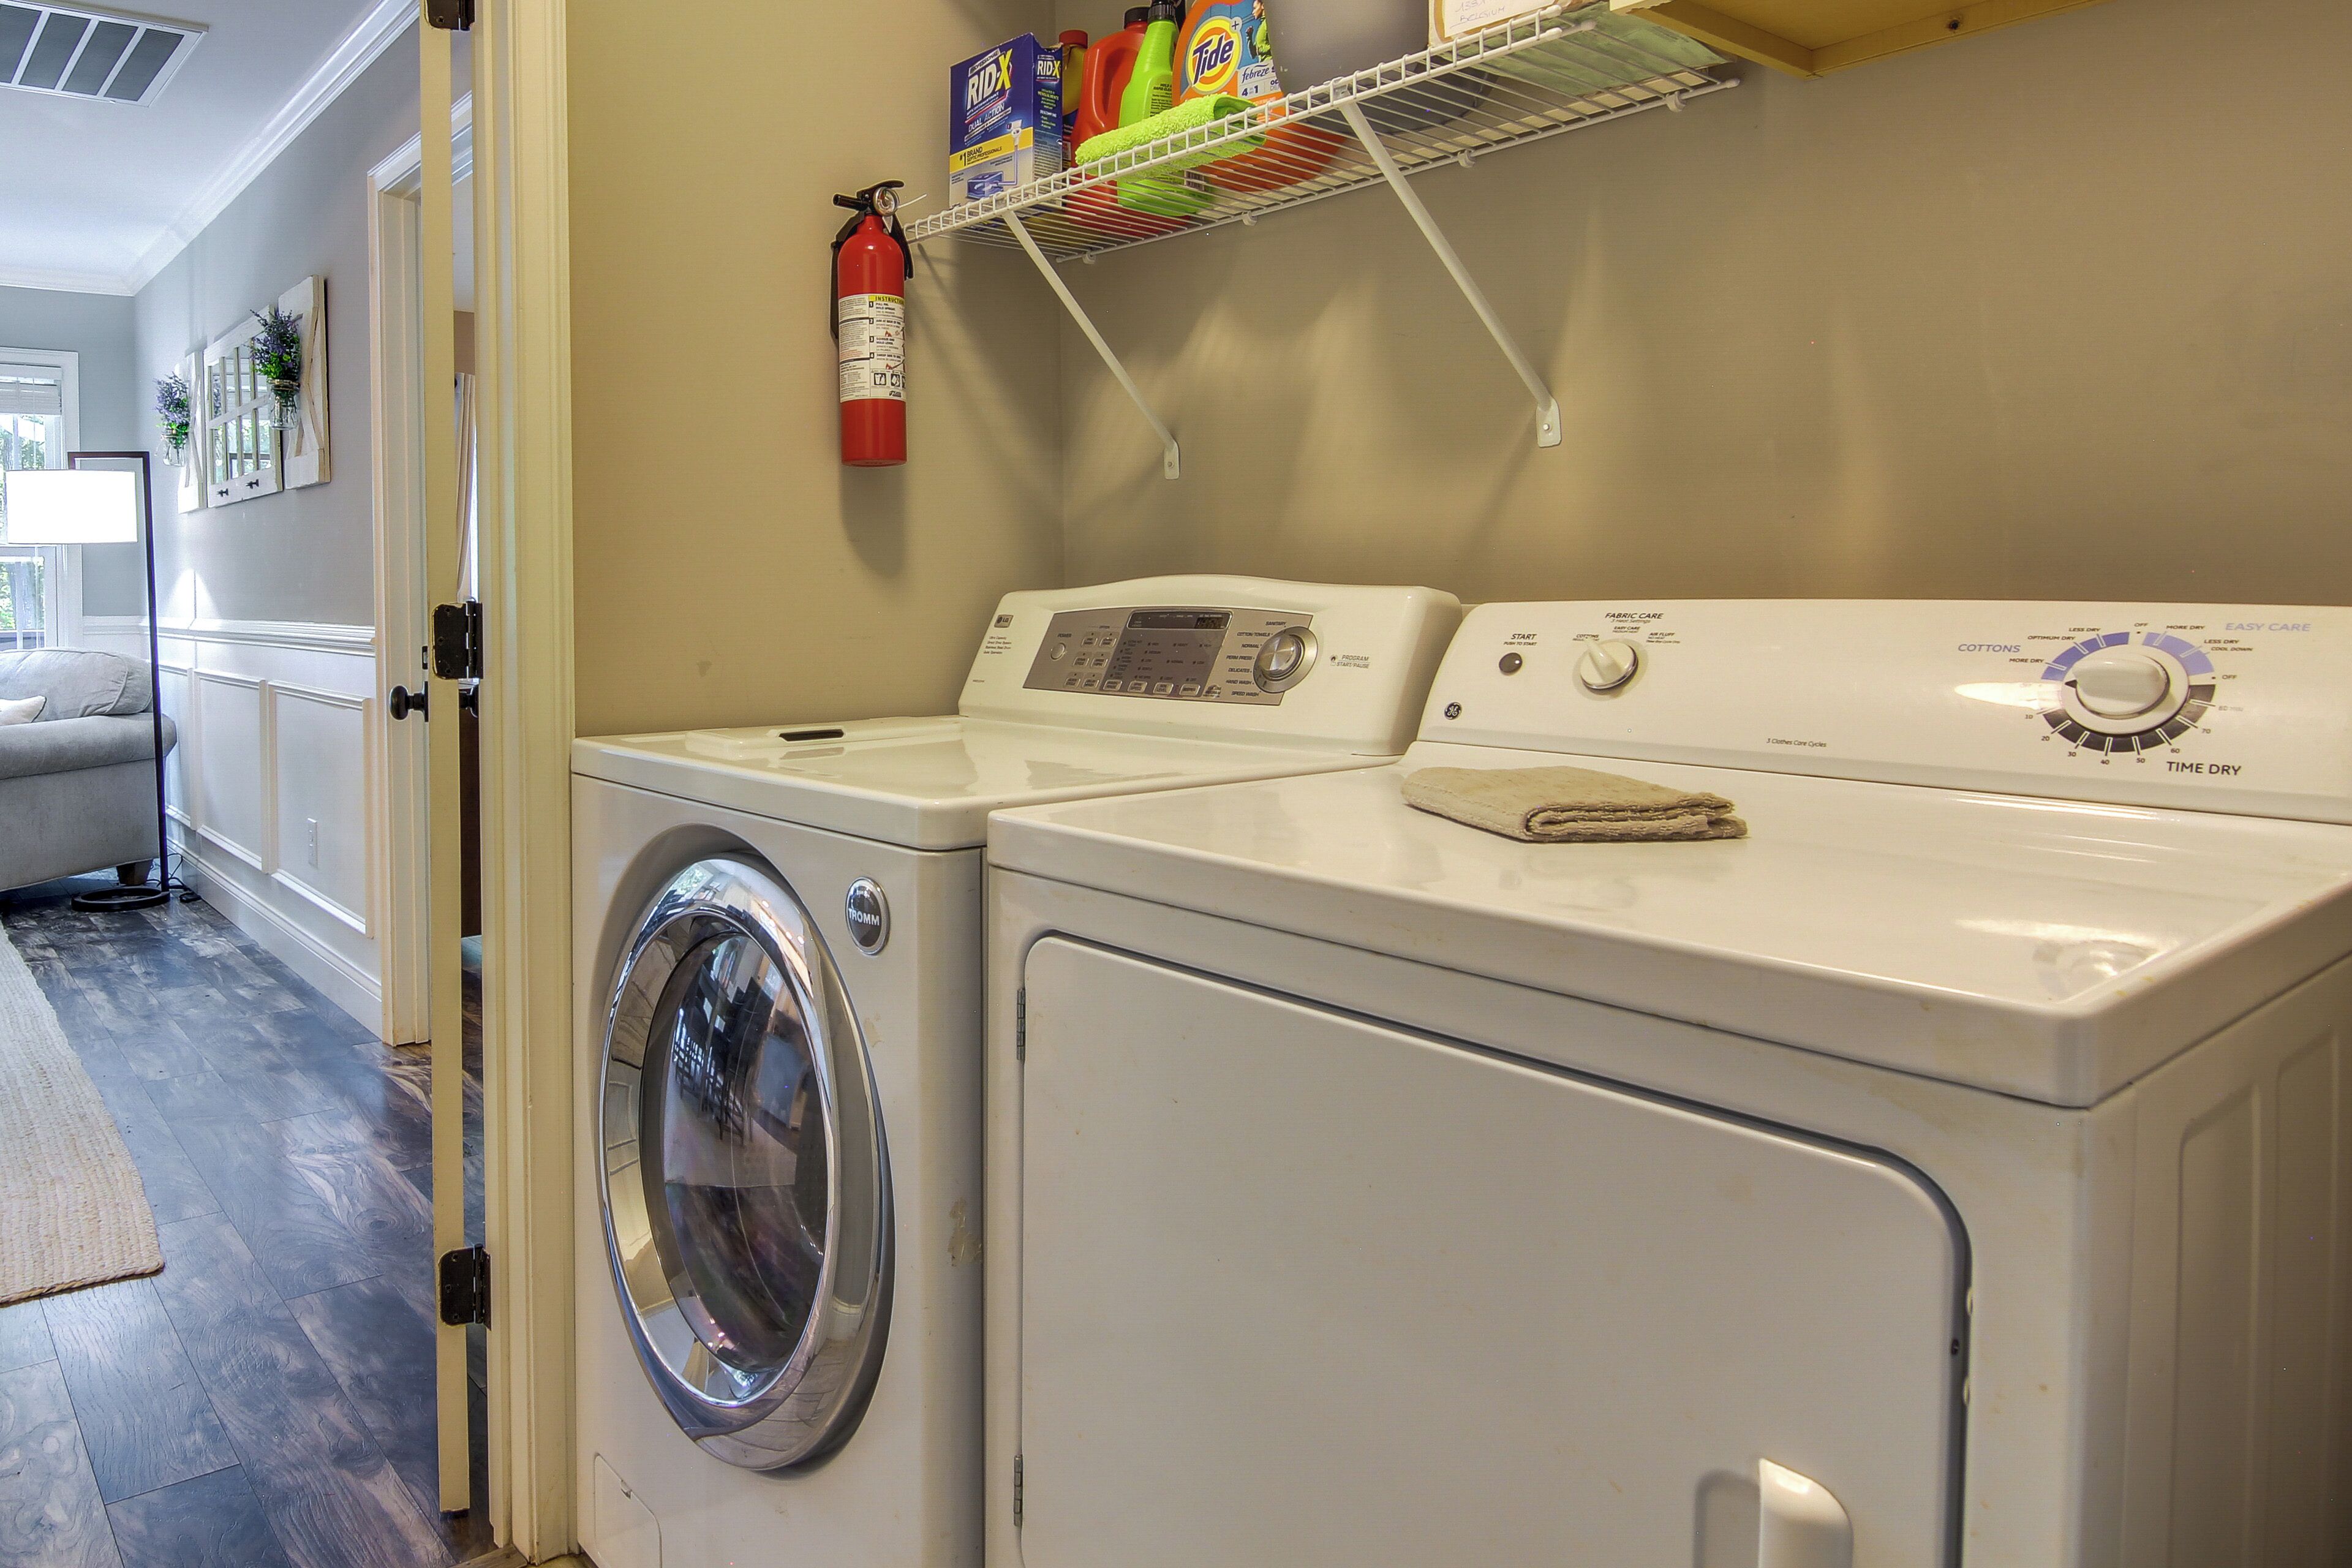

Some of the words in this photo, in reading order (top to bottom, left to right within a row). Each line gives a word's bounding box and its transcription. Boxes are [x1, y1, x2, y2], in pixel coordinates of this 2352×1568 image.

[1193, 34, 1234, 85] Tide
[1036, 60, 1060, 78] RID-X
[1242, 67, 1270, 83] febreze
[967, 48, 1013, 110] RID-X
[1242, 88, 1248, 97] 4
[1254, 85, 1259, 94] 1
[968, 116, 982, 133] DUAL
[984, 103, 1005, 121] ACTION
[967, 146, 983, 157] BRAND
[2225, 622, 2265, 631] EASY
[2267, 623, 2312, 632] CARE
[1958, 644, 2021, 653] COTTONS
[2166, 761, 2204, 774] TIME
[2208, 763, 2242, 776] DRY
[848, 908, 880, 926] TROMM
